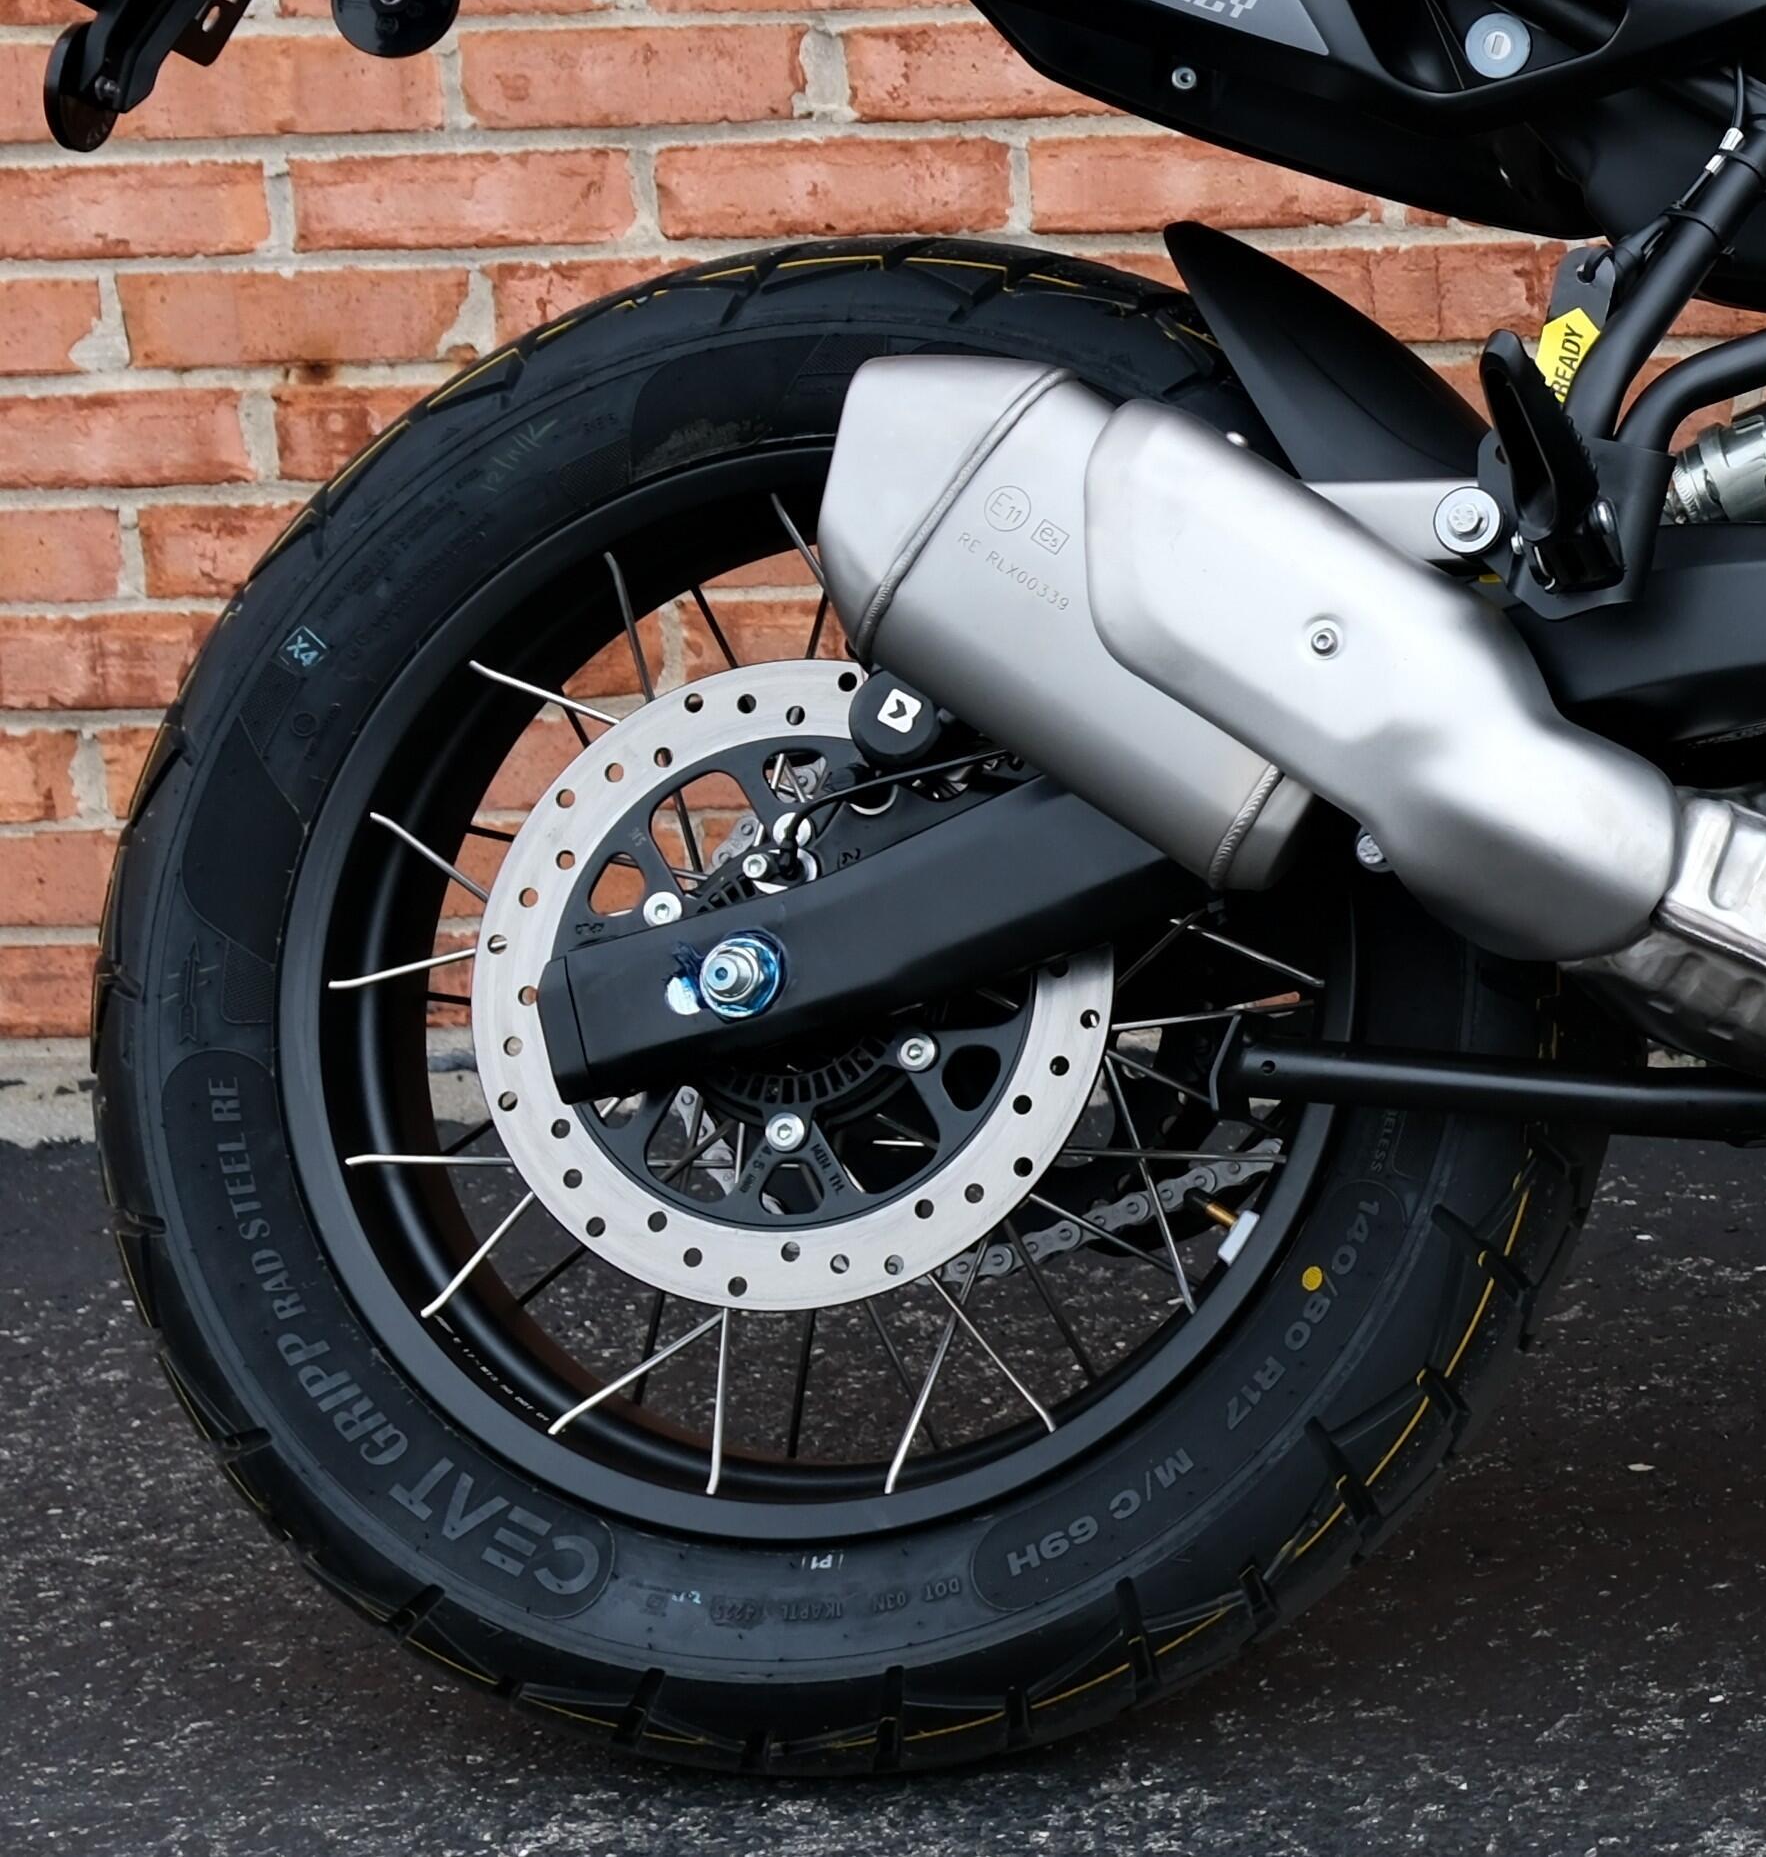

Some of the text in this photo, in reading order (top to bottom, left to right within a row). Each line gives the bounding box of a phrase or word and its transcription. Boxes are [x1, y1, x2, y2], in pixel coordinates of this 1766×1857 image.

[207, 1076, 240, 1123] RE
[217, 1128, 274, 1239] STEEL
[252, 1248, 308, 1322] RAD
[278, 1333, 410, 1466] GRIPP
[1007, 1198, 1382, 1577] 140/80 R17 M/C 69H
[387, 1456, 601, 1597] CEAT
[923, 1576, 961, 1603] DOT
